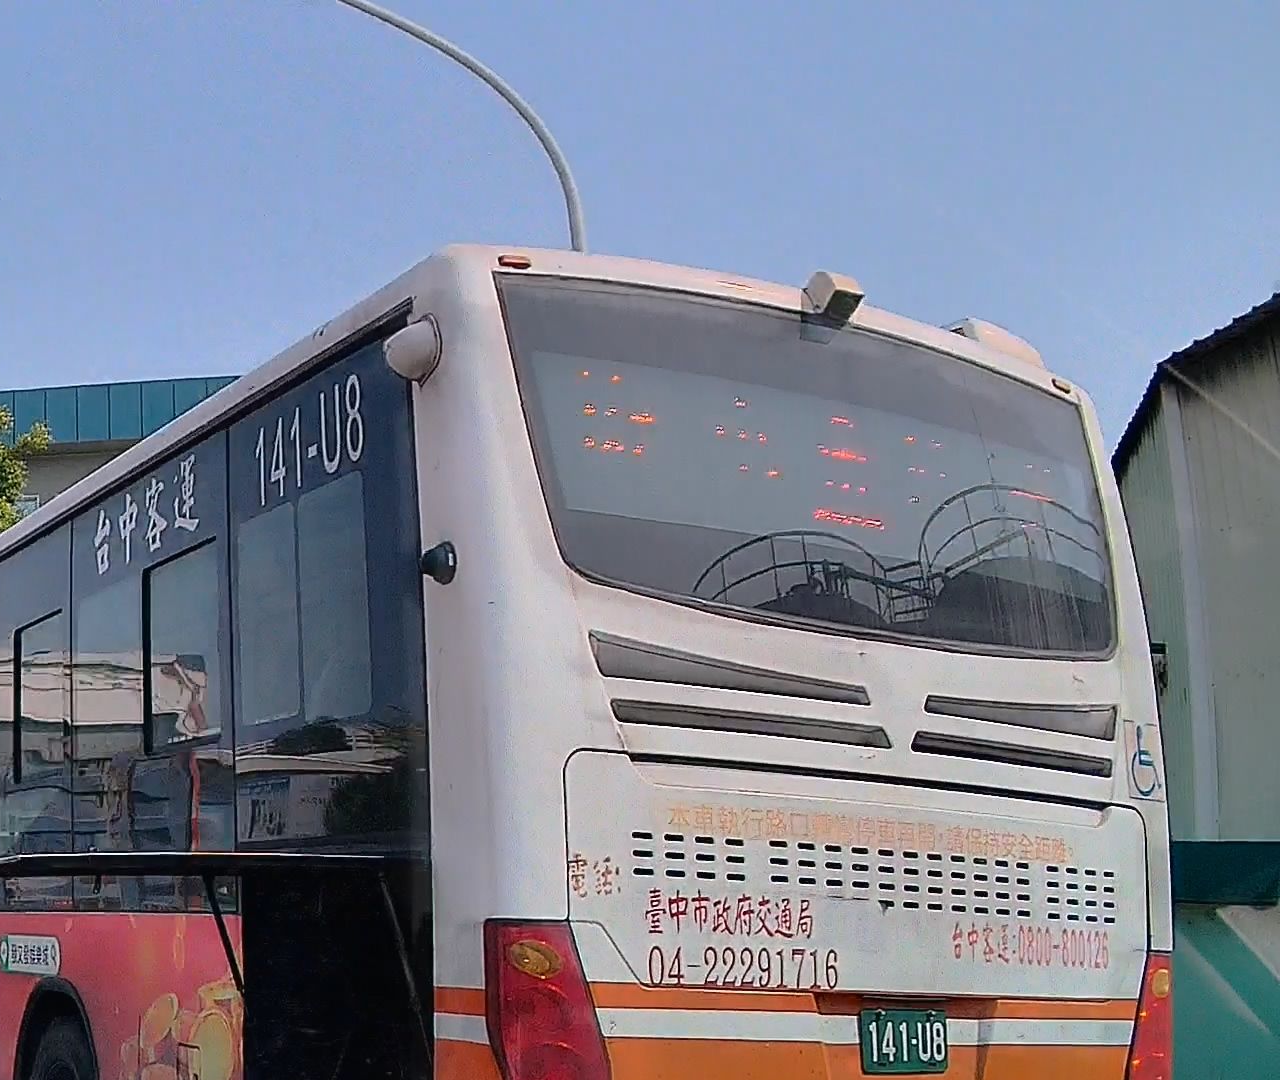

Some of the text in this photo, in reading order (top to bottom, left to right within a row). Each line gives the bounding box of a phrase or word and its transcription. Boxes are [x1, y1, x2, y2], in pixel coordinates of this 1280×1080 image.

[255, 374, 364, 506] 141-U8
[94, 454, 200, 575] 台中客運
[645, 887, 814, 939] 臺中市政府交通局
[647, 945, 839, 990] 04-22291716
